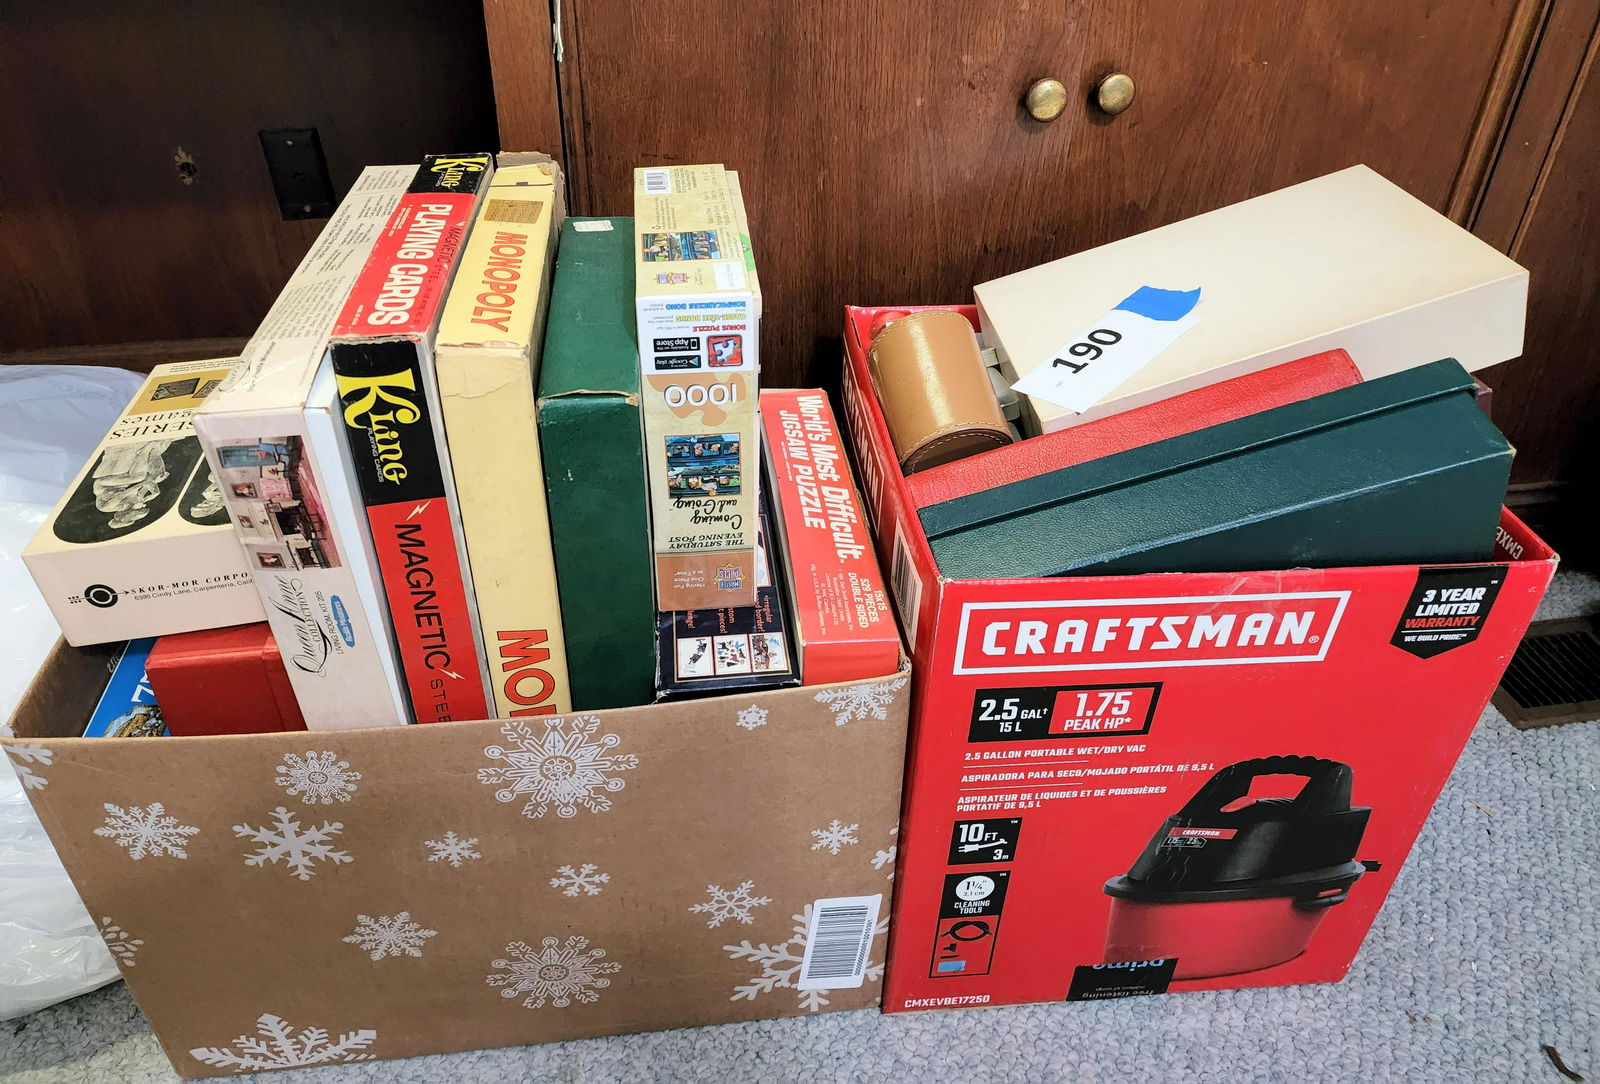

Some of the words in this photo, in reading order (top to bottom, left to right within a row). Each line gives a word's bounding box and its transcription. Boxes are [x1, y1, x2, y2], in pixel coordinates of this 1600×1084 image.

[430, 157, 489, 187] King
[397, 203, 453, 259] PLAYING
[471, 231, 528, 332] MONOPOLY
[367, 263, 428, 325] CARDS
[675, 339, 689, 347] App
[1052, 329, 1122, 374] 190
[664, 383, 737, 408] 1000
[120, 409, 194, 426] games
[335, 368, 421, 485] King
[797, 395, 832, 443] World's
[780, 410, 809, 461] JIGSAW
[811, 443, 841, 482] Most
[672, 495, 718, 514] Going
[718, 499, 737, 513] and
[793, 463, 826, 530] PUZZLE
[691, 510, 742, 529] Coming
[668, 535, 696, 543] POST
[669, 540, 722, 549] SATURDAY
[699, 531, 743, 541] EVENING
[131, 579, 199, 594] SKOR-MOR
[134, 592, 151, 601] 6390
[152, 590, 172, 599] Cindy
[174, 587, 192, 596] Lane,
[194, 582, 236, 593] Carpenteria,
[860, 578, 872, 592] 529
[395, 524, 451, 671] MAGNETIC
[848, 572, 863, 602] DOUBLE
[856, 604, 869, 628] SIDED
[874, 590, 887, 610] 15x15
[1422, 589, 1437, 603] 3
[1440, 587, 1487, 602] YEAR
[290, 578, 322, 642] COLLECTION
[318, 602, 328, 613] KIT
[864, 593, 879, 622] PIECES
[1415, 603, 1480, 616] LIMITED
[756, 609, 766, 632] border!
[1405, 616, 1481, 629] WARRANTY
[981, 611, 1316, 656] CRAFTSMAN
[331, 634, 344, 655] LIVING
[979, 698, 1020, 721] 2.5
[1076, 691, 1133, 717] 1.75
[1000, 722, 1014, 733] 15
[1015, 721, 1022, 732] L
[1064, 719, 1102, 731] PEAK
[965, 752, 981, 760] 2.5
[983, 750, 1022, 760] GALLON
[1024, 748, 1074, 758] PORTABLE
[1077, 745, 1124, 756] WET/DRY
[1127, 744, 1146, 752] VAC
[961, 772, 1025, 782] ASPIRADORA
[1027, 770, 1054, 779] PARA
[1057, 767, 1128, 777] SECO/MOJADO
[1130, 763, 1174, 774] PORTÁTIL
[1191, 763, 1207, 772] 9,5
[957, 794, 1018, 804] ASPIRATEUR
[1020, 793, 1032, 801] DE
[1035, 790, 1078, 800] LIQUIDES
[1080, 790, 1091, 798] ET
[1094, 789, 1106, 797] DE
[1108, 785, 1167, 796] POUSSIÈRES
[956, 802, 1001, 812] PORTATIF
[1004, 801, 1017, 809] DE
[1019, 801, 1034, 809] 9,5
[1036, 800, 1041, 808] L
[954, 900, 990, 909] CLEANING
[904, 995, 990, 1008] CMXEVBE17250
[1082, 991, 1130, 999] listening
